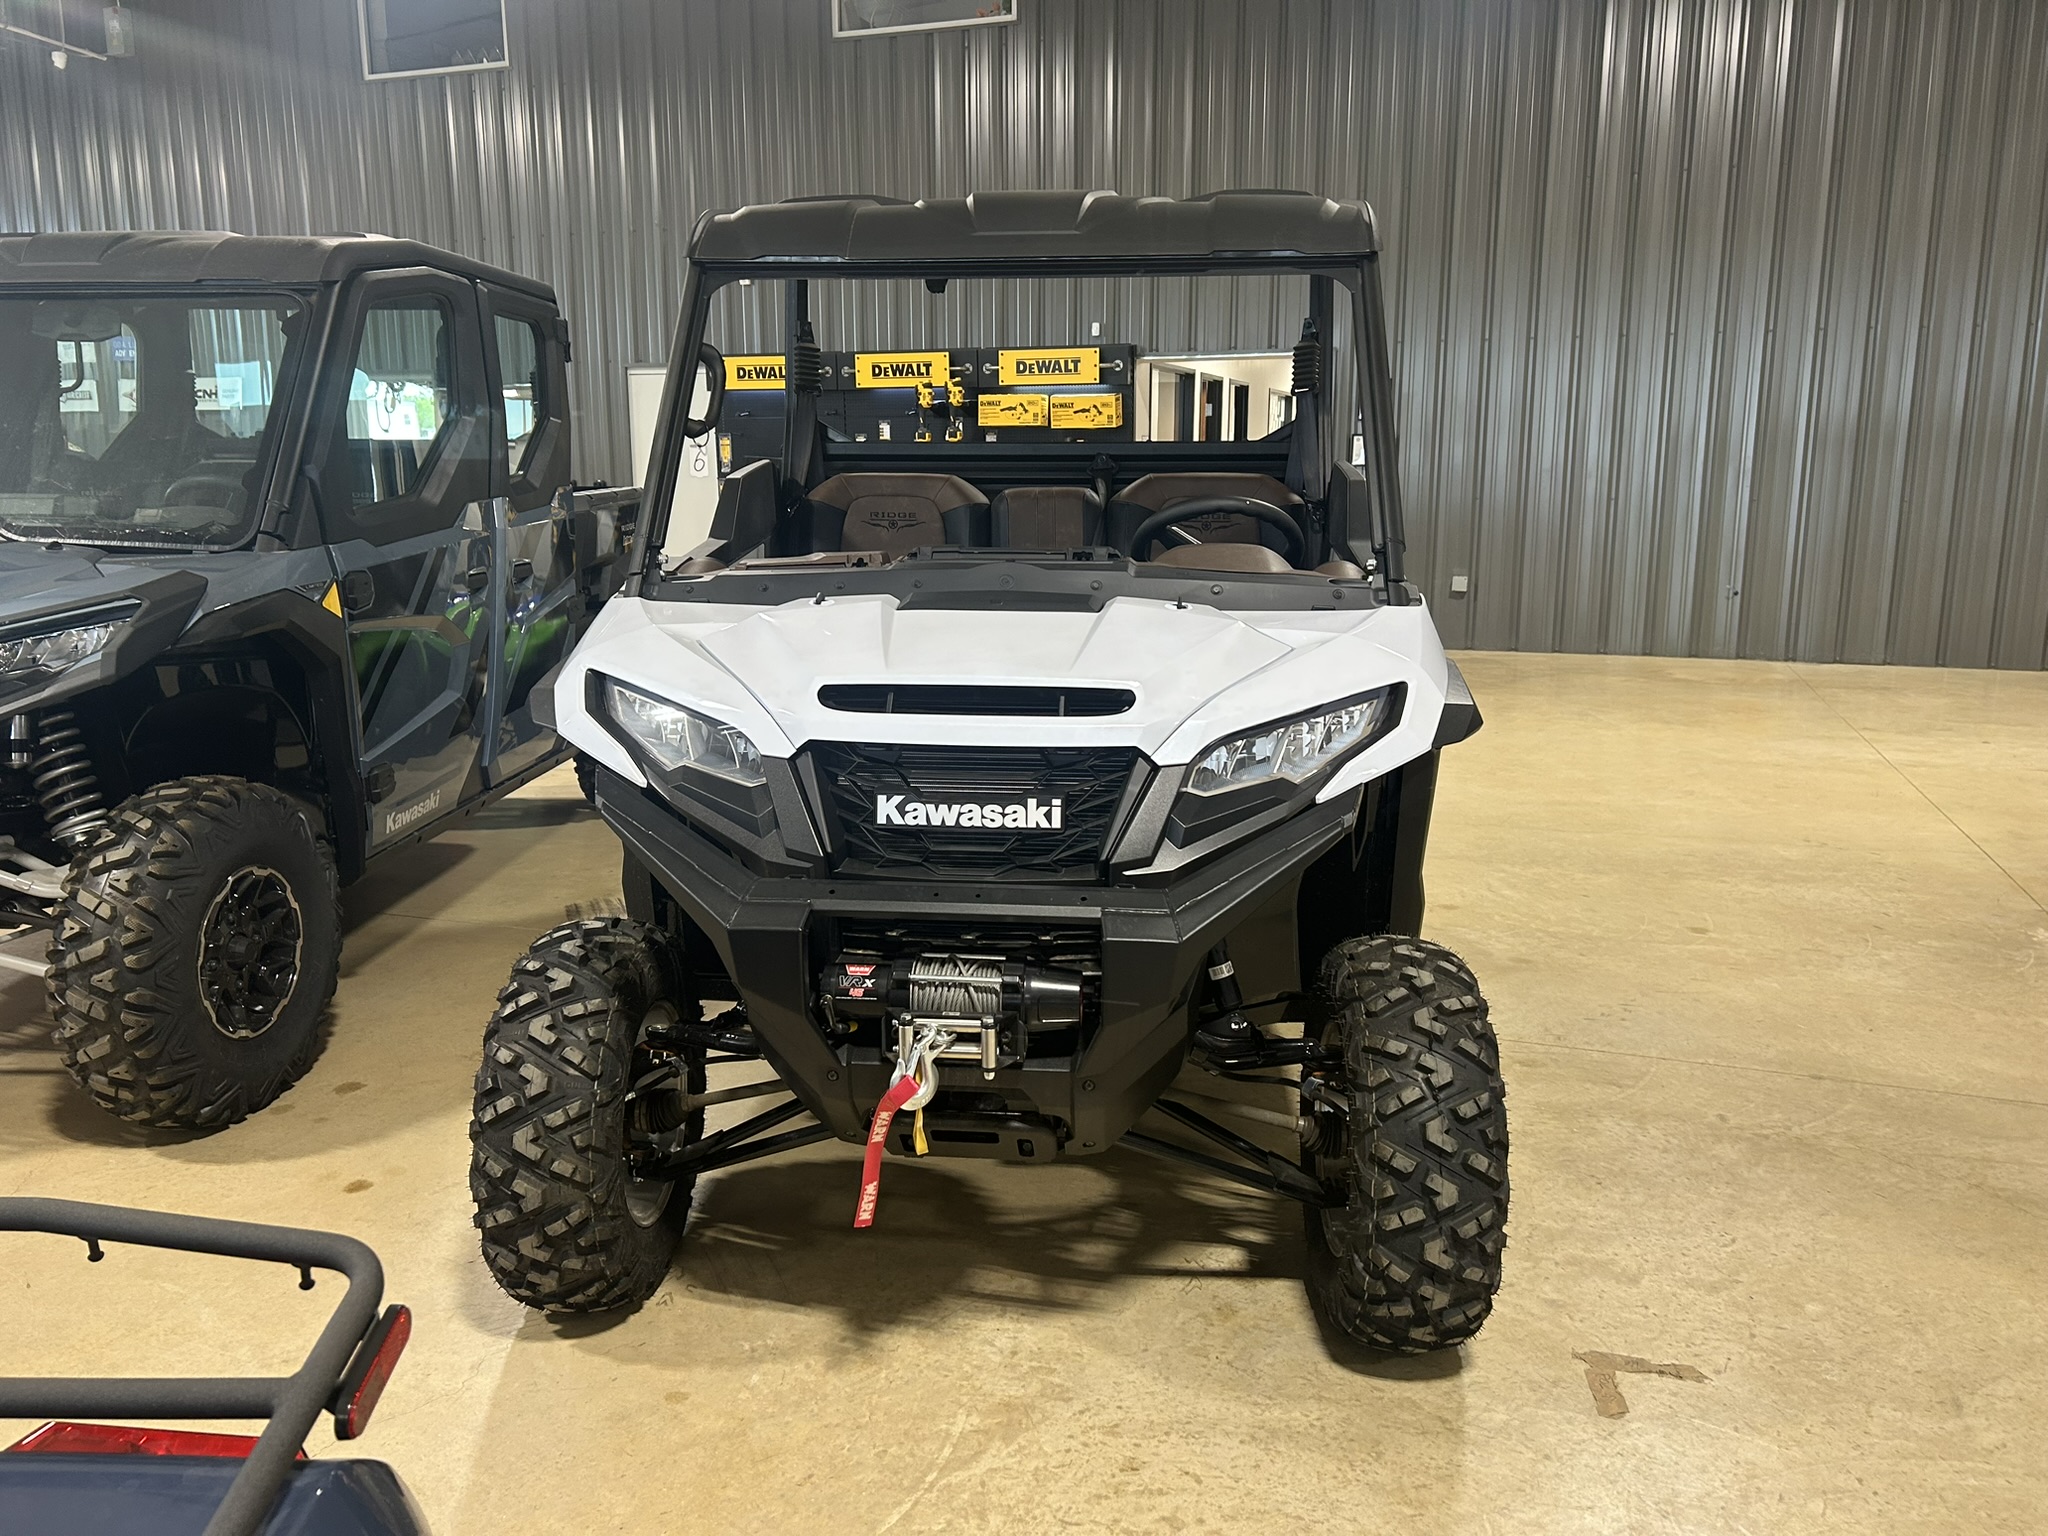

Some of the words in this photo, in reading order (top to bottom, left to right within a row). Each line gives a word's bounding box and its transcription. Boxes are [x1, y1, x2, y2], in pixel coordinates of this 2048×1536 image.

[736, 366, 785, 379] DEWAL
[871, 362, 931, 377] DEWALT
[1015, 359, 1081, 374] DEWALT
[869, 511, 917, 519] RIDGE
[386, 789, 440, 834] Kawasaki
[876, 794, 1062, 830] Kawasaki
[870, 1111, 892, 1143] WARN
[858, 1181, 878, 1220] WARN
